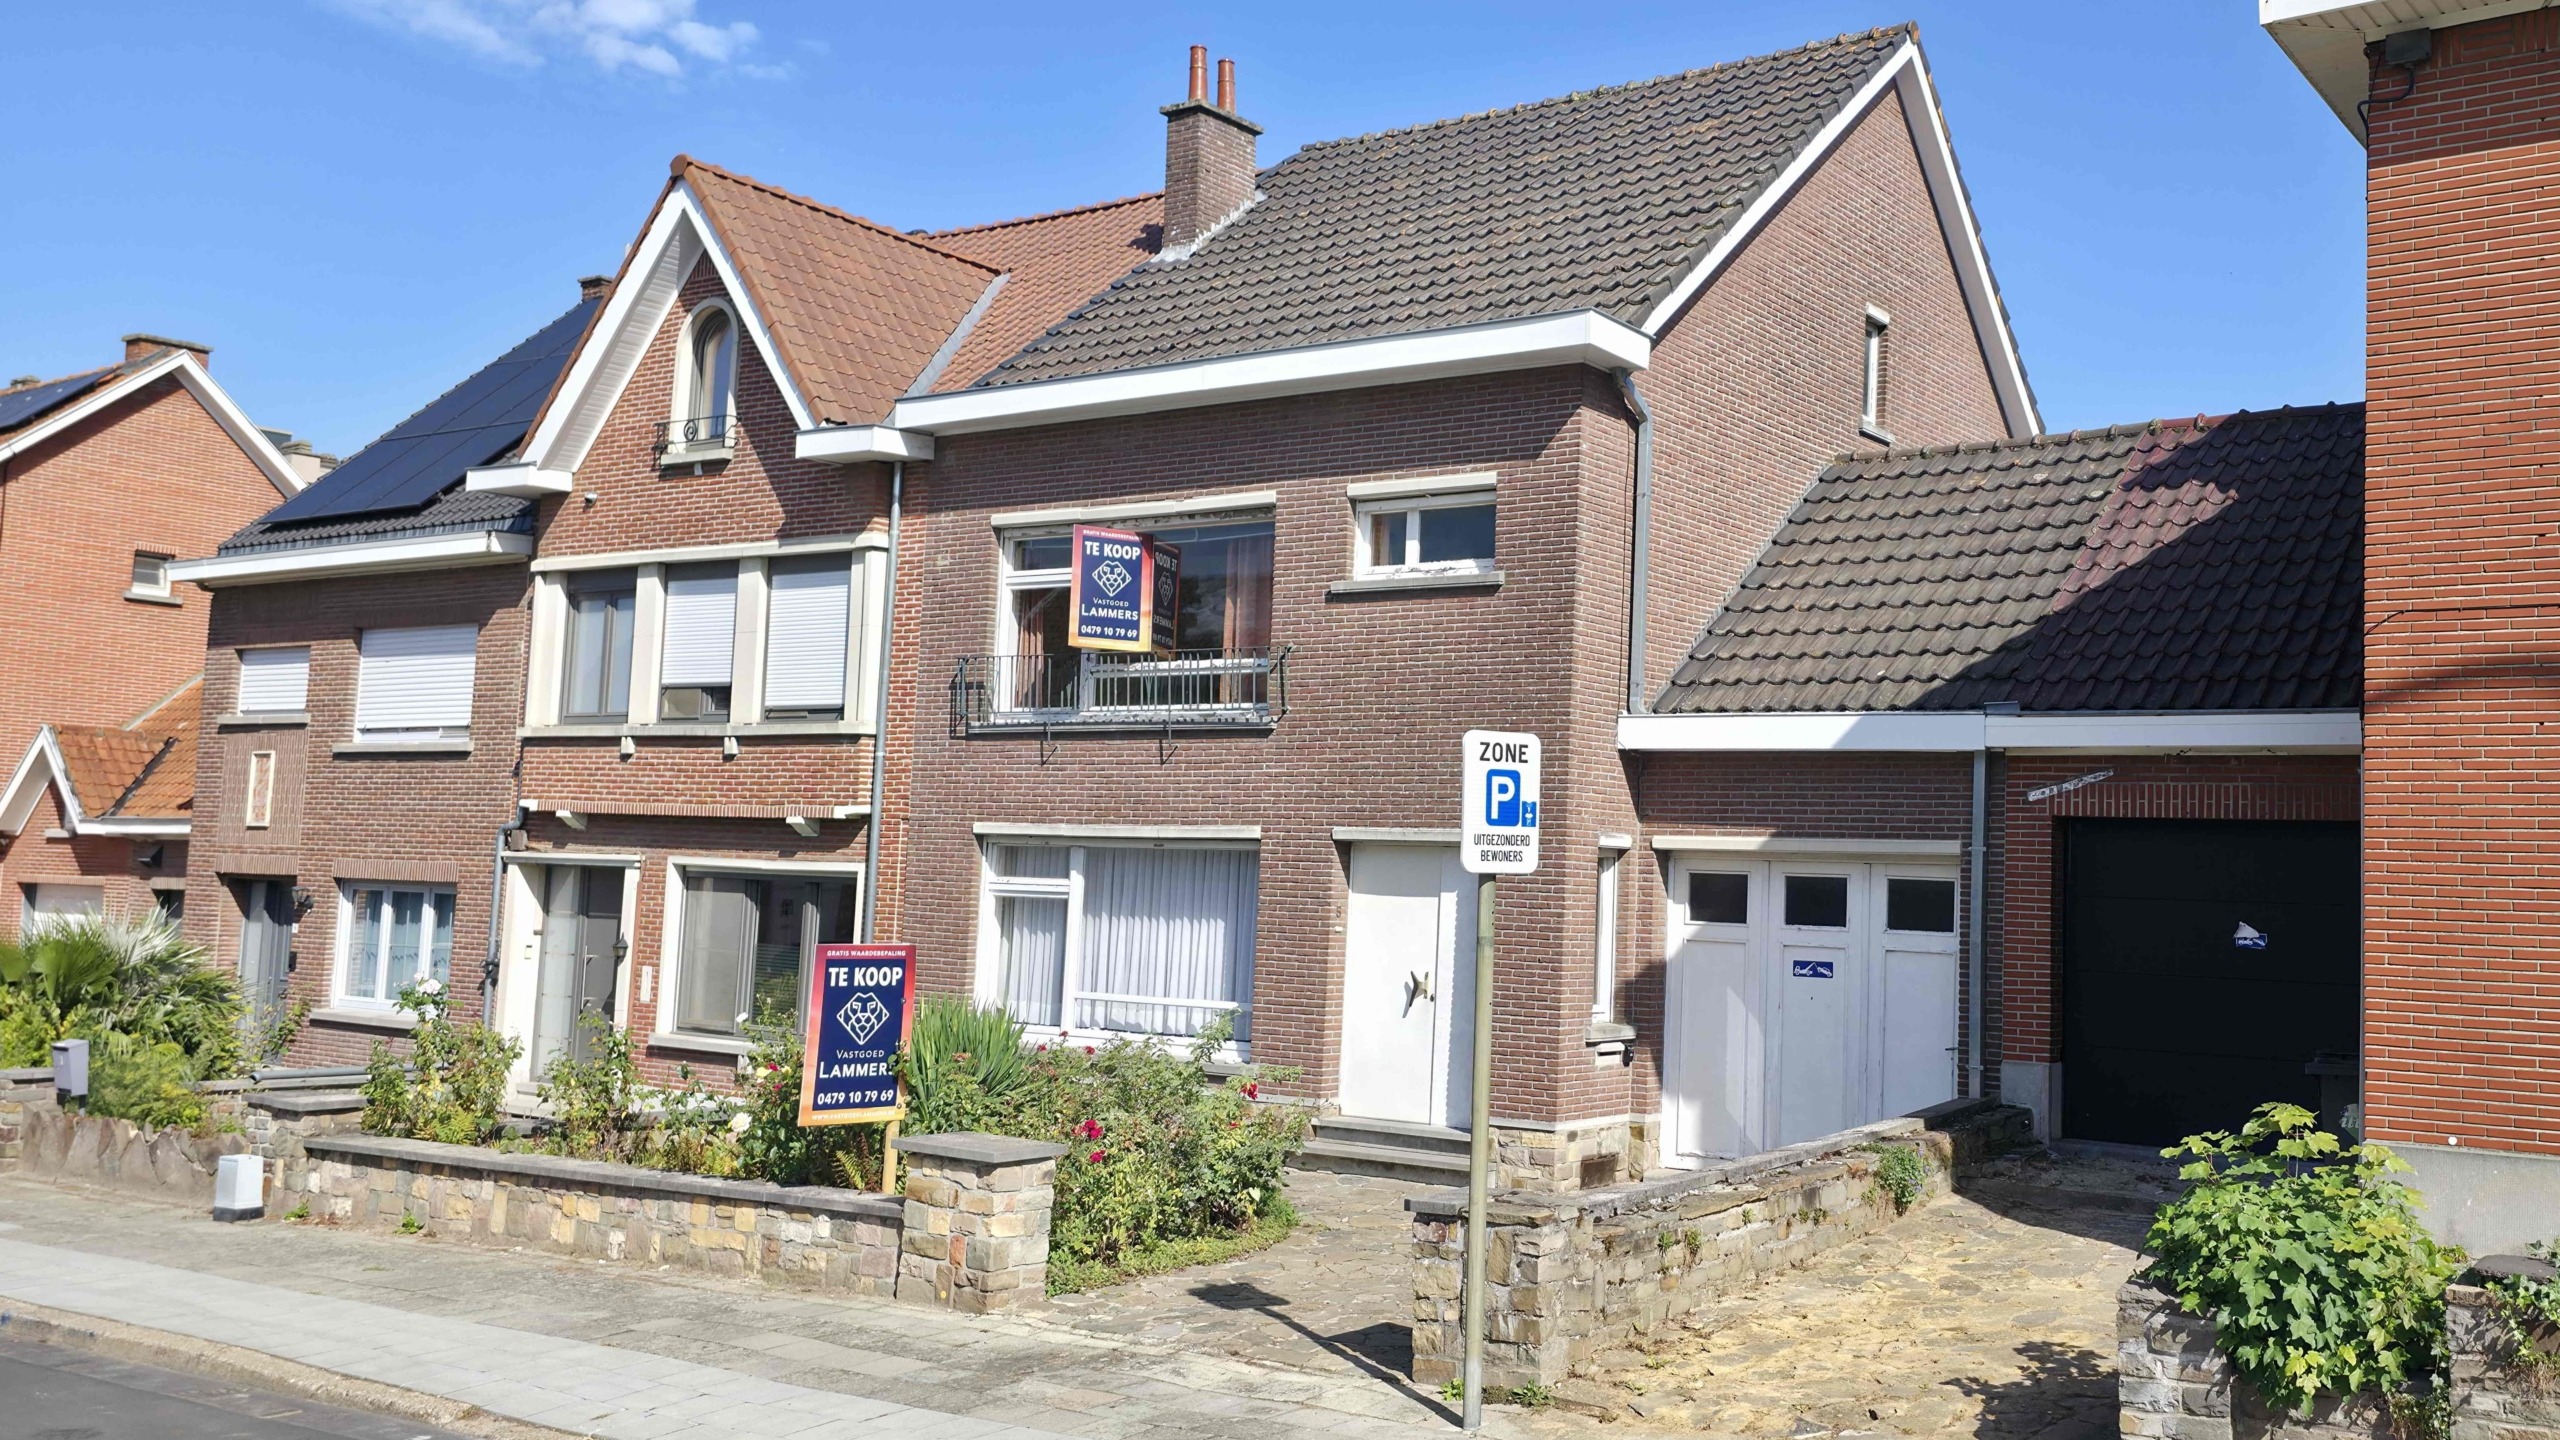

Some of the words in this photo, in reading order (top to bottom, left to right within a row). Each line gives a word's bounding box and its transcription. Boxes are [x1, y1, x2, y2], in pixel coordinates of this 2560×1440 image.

[1084, 541, 1100, 556] TE
[1103, 543, 1141, 560] KOOP
[1093, 597, 1129, 607] VASTGOED
[1081, 604, 1139, 621] LAMMERS
[1081, 624, 1101, 635] 0479
[1104, 627, 1114, 636] 10
[1115, 628, 1126, 638] 79
[1127, 629, 1138, 638] 69
[1479, 742, 1529, 763] ZONE
[1490, 775, 1516, 820] P
[1473, 834, 1531, 847] UITGEZONDERD
[1480, 850, 1523, 862] BEWONERS
[828, 967, 849, 987] TE
[853, 966, 903, 987] KOOP
[836, 1049, 885, 1059] VASTGOED
[817, 1092, 845, 1105] 0479
[849, 1091, 861, 1103] 10
[864, 1090, 878, 1102] 79
[880, 1089, 894, 1102] 69
